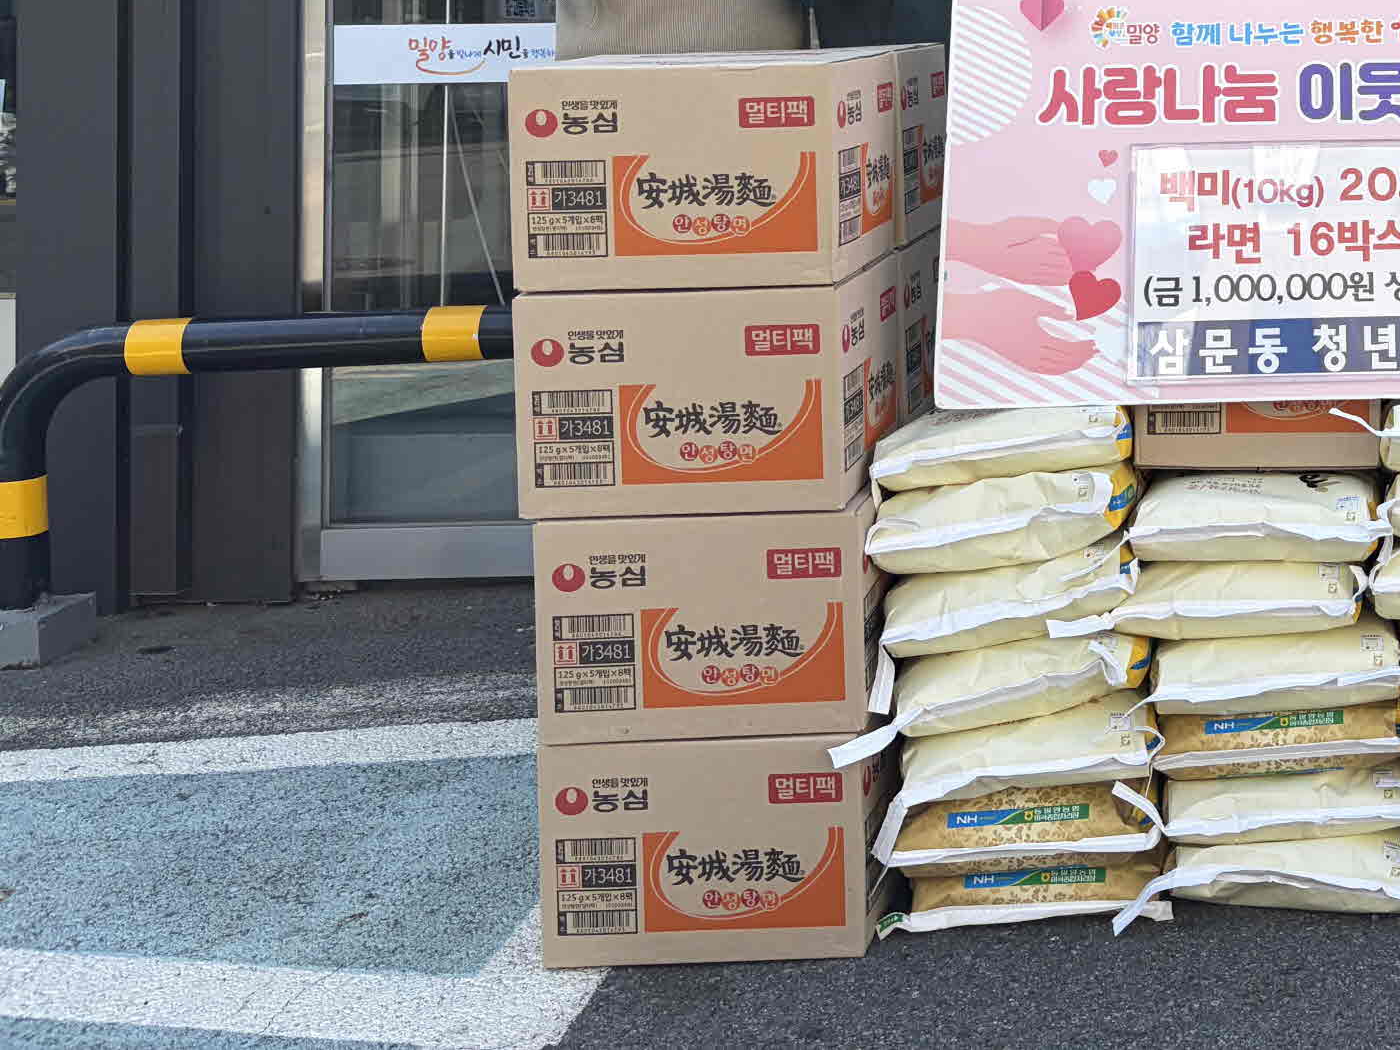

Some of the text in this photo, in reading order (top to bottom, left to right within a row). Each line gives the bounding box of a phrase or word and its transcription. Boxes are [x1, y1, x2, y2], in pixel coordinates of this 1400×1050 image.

[1126, 23, 1160, 44] 밀양
[1170, 21, 1222, 47] 함께
[1228, 21, 1304, 45] 나누는
[1309, 18, 1384, 45] 행복한
[562, 100, 618, 110] 인생을 맛있게
[1037, 62, 1279, 125] 사랑나눔
[561, 111, 618, 135] 농심
[745, 100, 808, 124] 멀티팩
[554, 190, 603, 207] 가3481
[636, 172, 776, 209] 安城湯麵
[1160, 167, 1324, 212] 백미(10kg)
[673, 214, 750, 236] 안성탕면
[1187, 221, 1261, 265] 라면
[1143, 277, 1182, 308] (금
[1193, 270, 1375, 306] 1,000,000원
[567, 328, 624, 338] 인생을 맛있게
[751, 328, 814, 352] 멀티팩
[567, 339, 624, 363] 농심
[1148, 323, 1287, 377] 삼문동
[560, 419, 610, 436] 가3481
[643, 401, 782, 438] 安城湯麵
[680, 443, 757, 465] 안성탕면
[589, 553, 646, 563] 인생을 맛있게
[773, 551, 836, 575] 멀티팩
[588, 564, 646, 588] 농심
[581, 644, 631, 661] 가3481
[664, 624, 804, 661] 安城湯麵
[701, 666, 778, 688] 안성탕면
[1214, 721, 1234, 731] NH
[592, 777, 648, 788] 인생을 맛있게
[774, 776, 837, 800] 멀티팩
[591, 789, 648, 812] 농심
[956, 815, 978, 825] NH
[584, 867, 632, 884] 가3481
[665, 848, 805, 885] 安城湯麵
[973, 875, 994, 885] NH
[702, 890, 779, 912] 안성탕면
